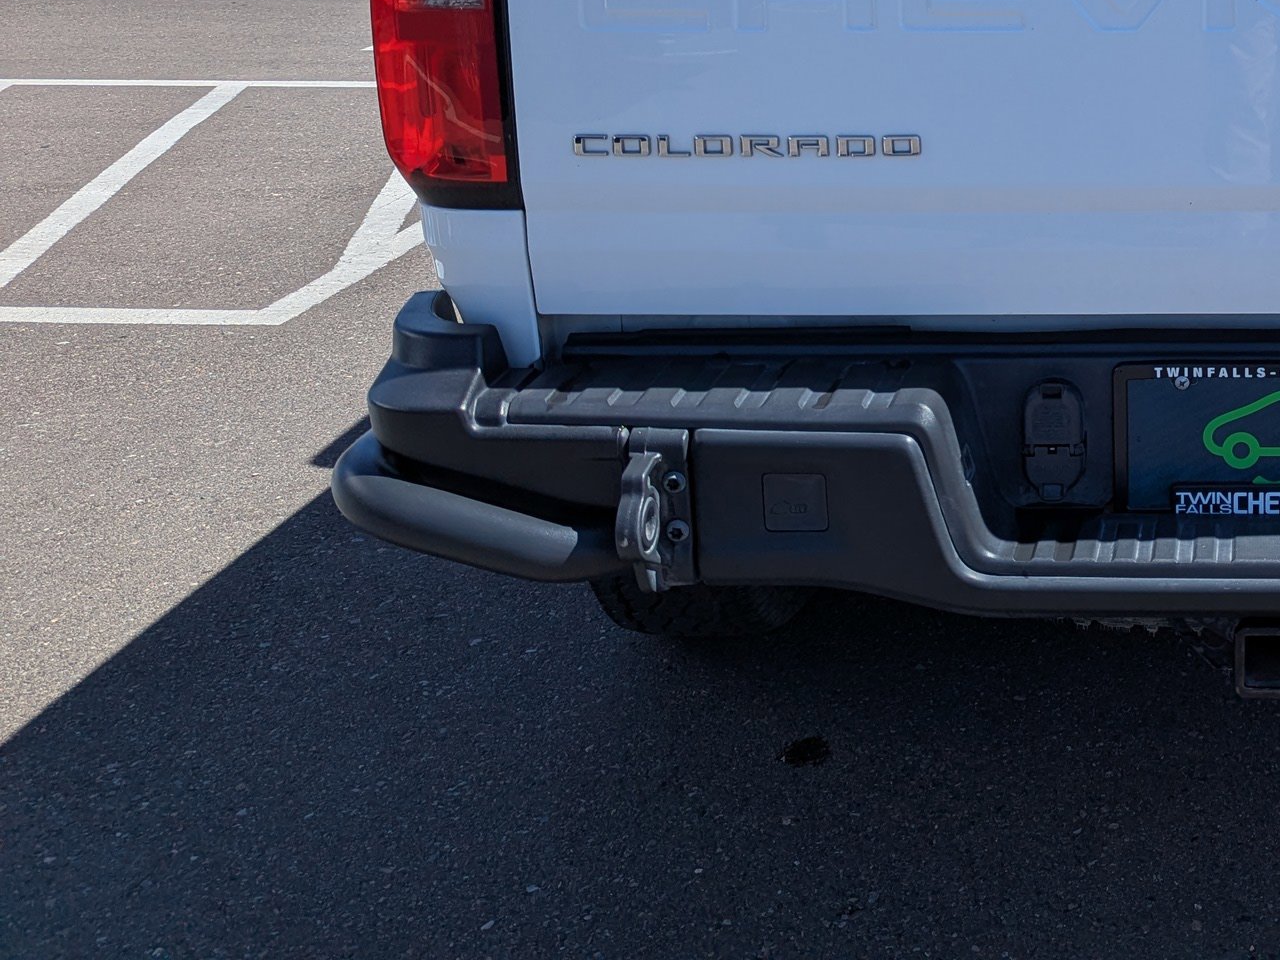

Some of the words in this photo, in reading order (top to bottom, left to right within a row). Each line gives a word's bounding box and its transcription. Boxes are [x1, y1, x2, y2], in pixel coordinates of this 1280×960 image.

[572, 133, 922, 157] COLORADO
[1175, 492, 1232, 504] TWIN
[1175, 504, 1232, 515] FALLS
